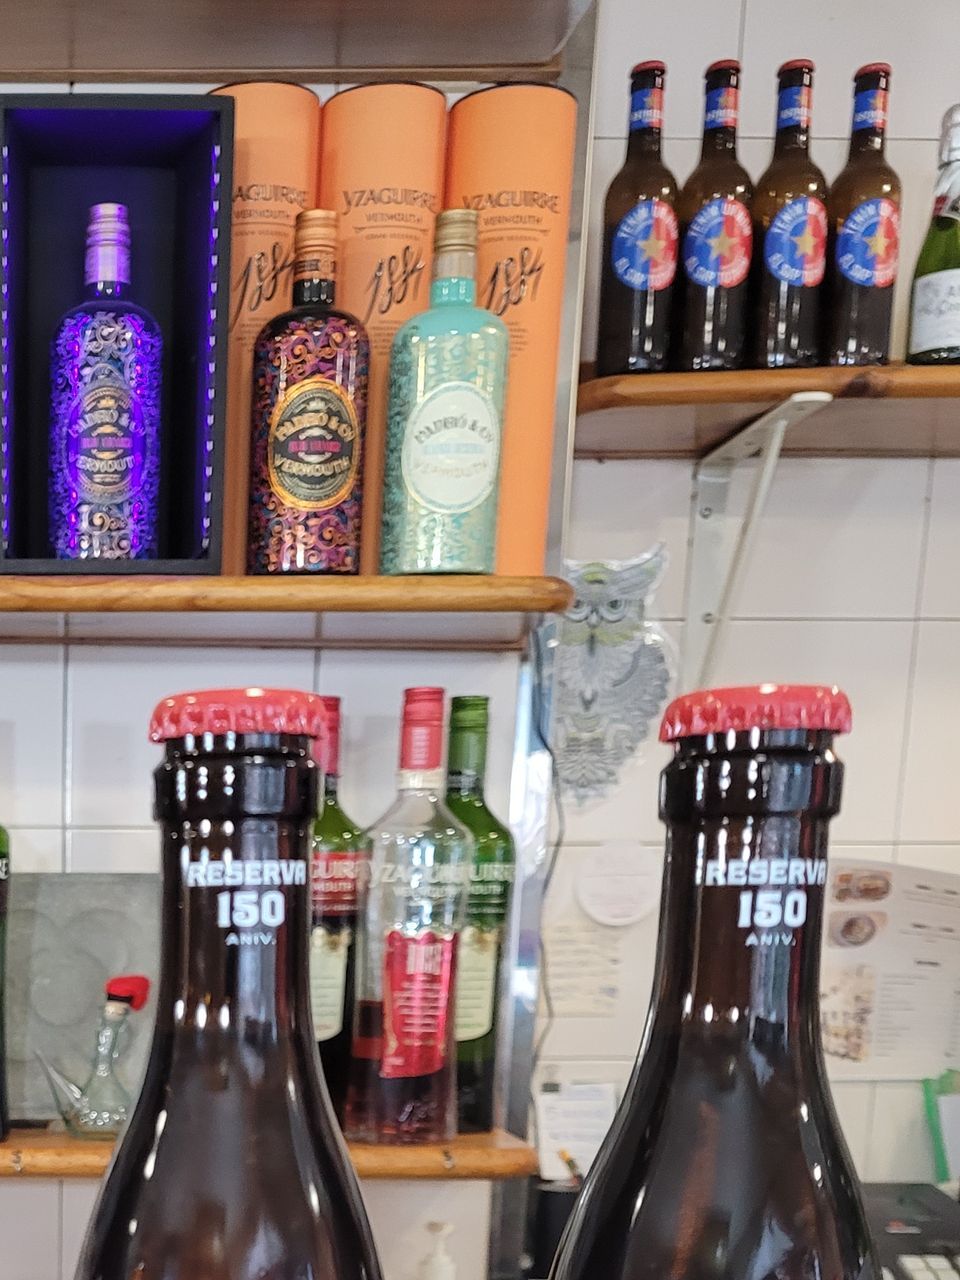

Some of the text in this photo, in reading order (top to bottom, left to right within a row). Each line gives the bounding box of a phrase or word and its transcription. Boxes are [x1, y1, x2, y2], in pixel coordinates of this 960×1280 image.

[187, 859, 307, 887] RESERVA
[705, 858, 828, 886] RESERVA
[217, 890, 285, 928] 150
[737, 890, 807, 928] 150
